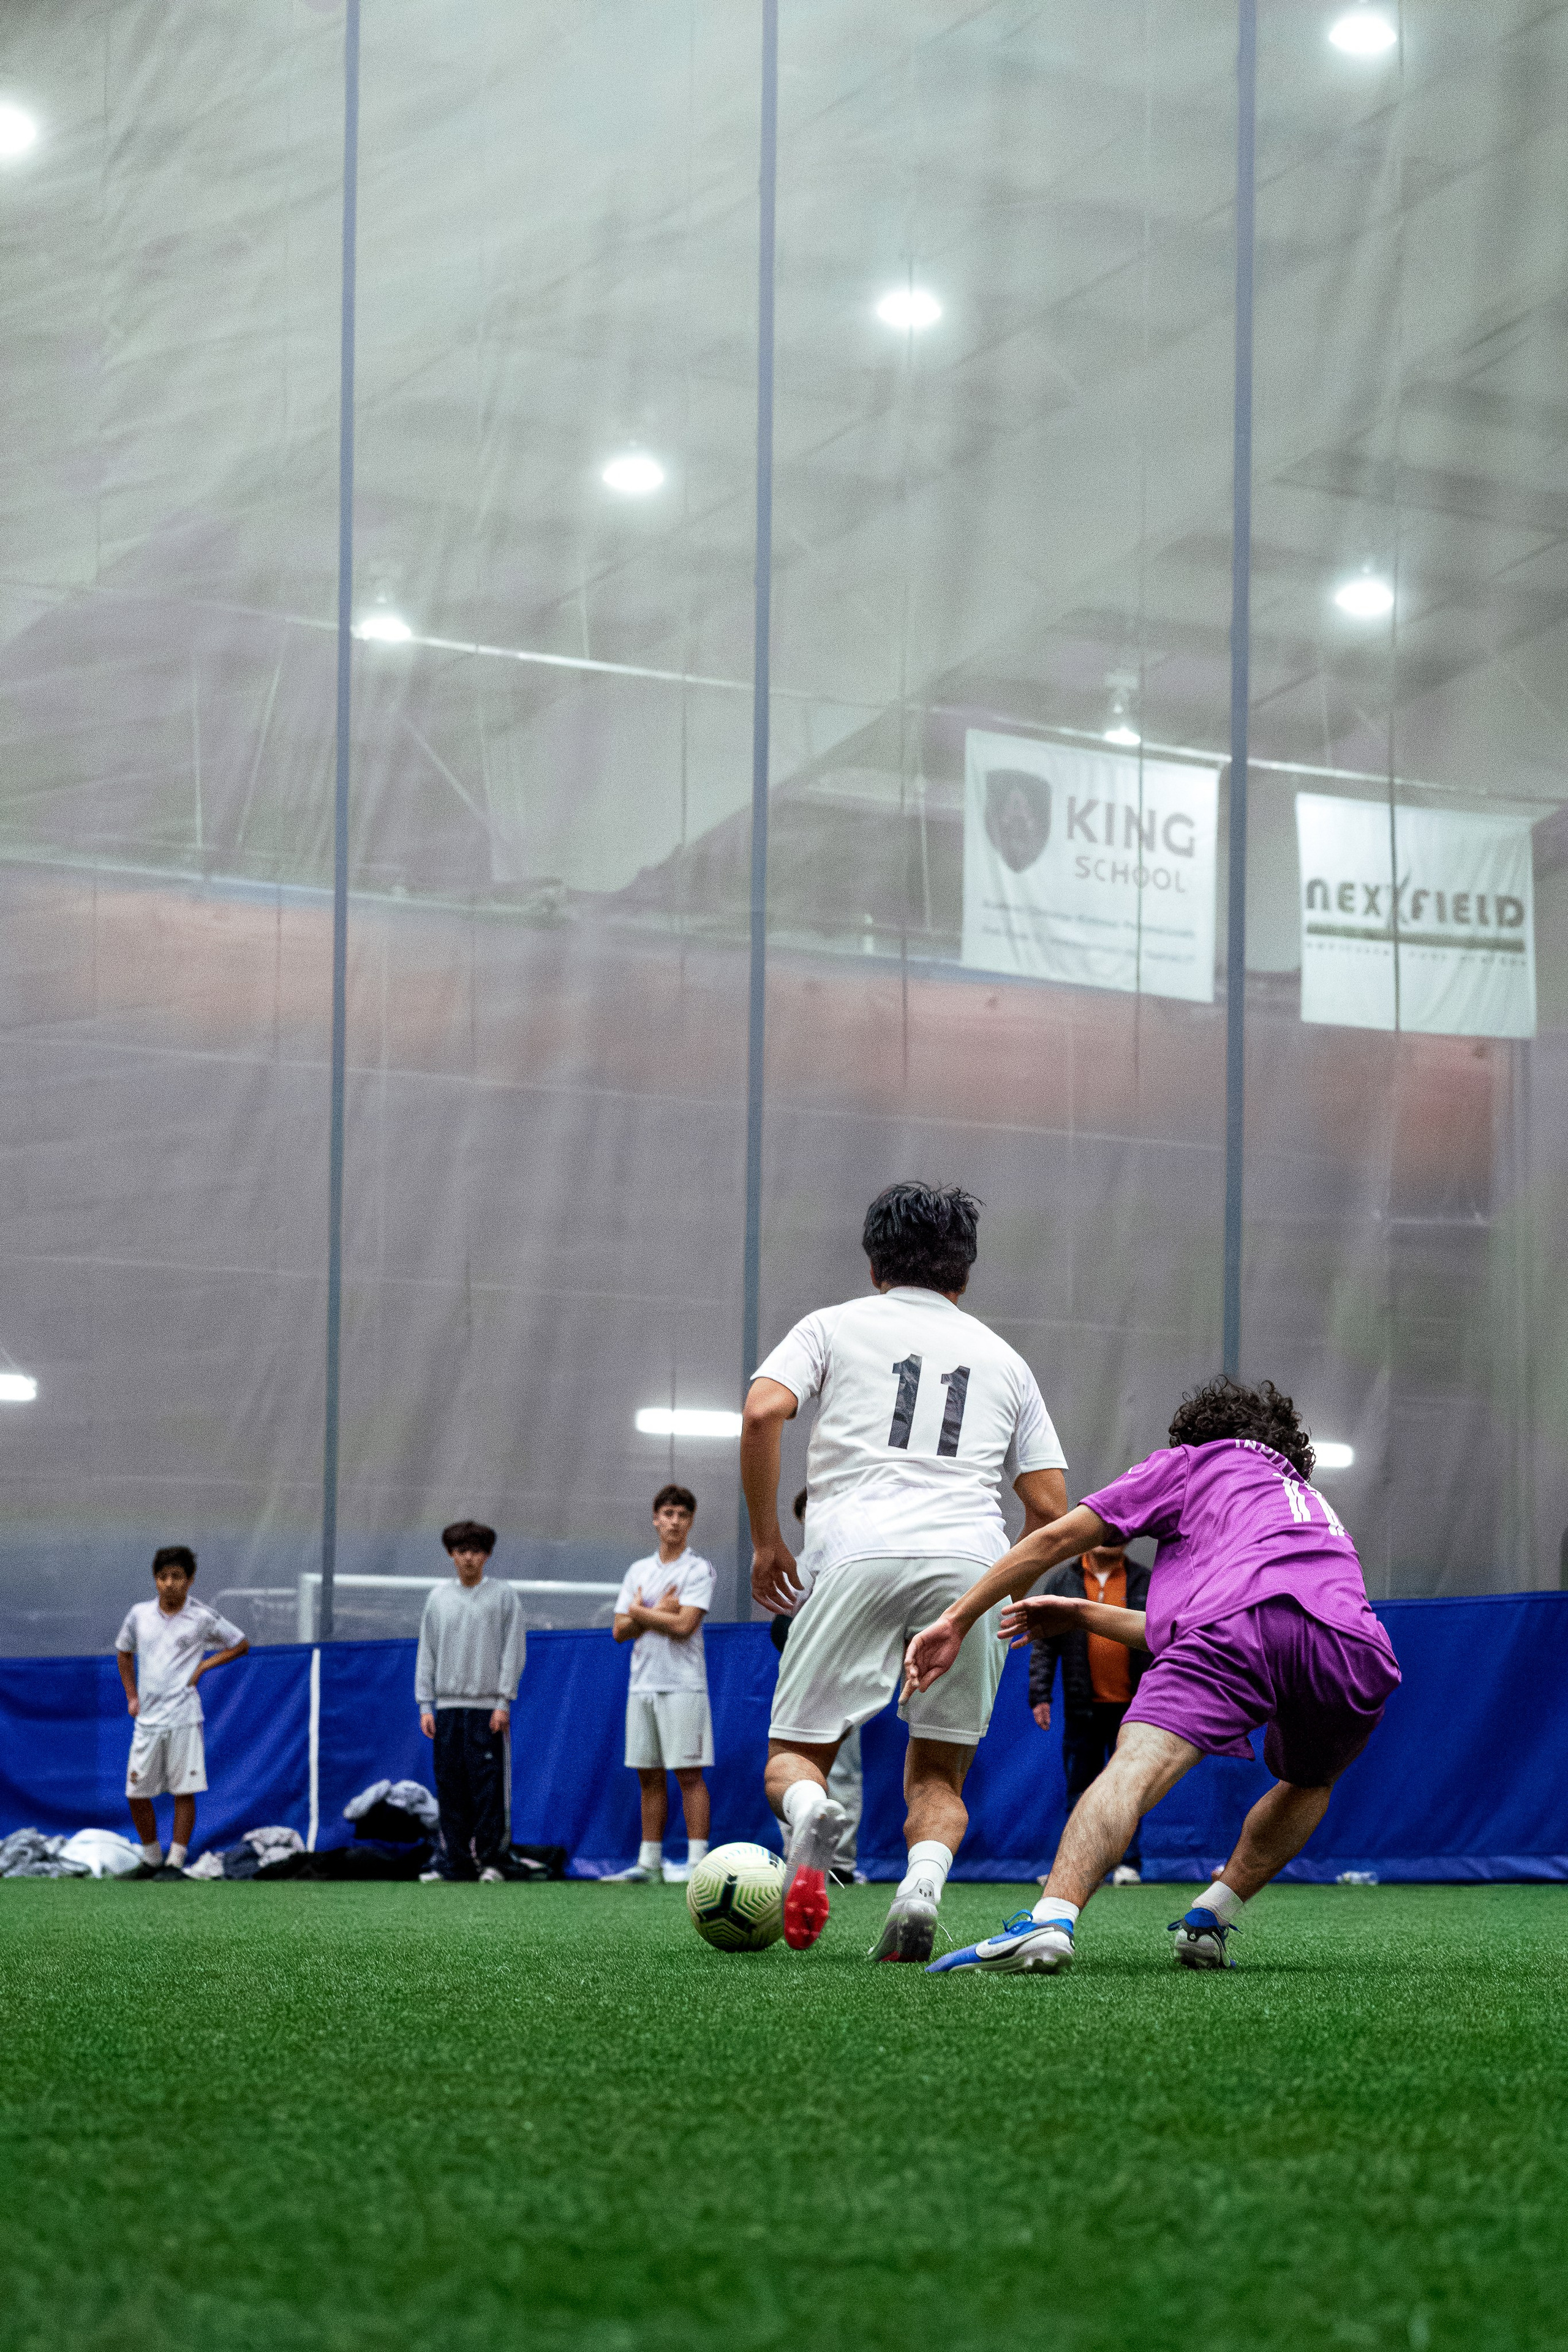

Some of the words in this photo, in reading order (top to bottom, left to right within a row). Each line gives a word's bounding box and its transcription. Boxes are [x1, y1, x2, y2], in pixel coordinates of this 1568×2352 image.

[1066, 796, 1196, 858] KING
[1075, 856, 1186, 894] SCHOOL
[888, 1353, 971, 1458] 11
